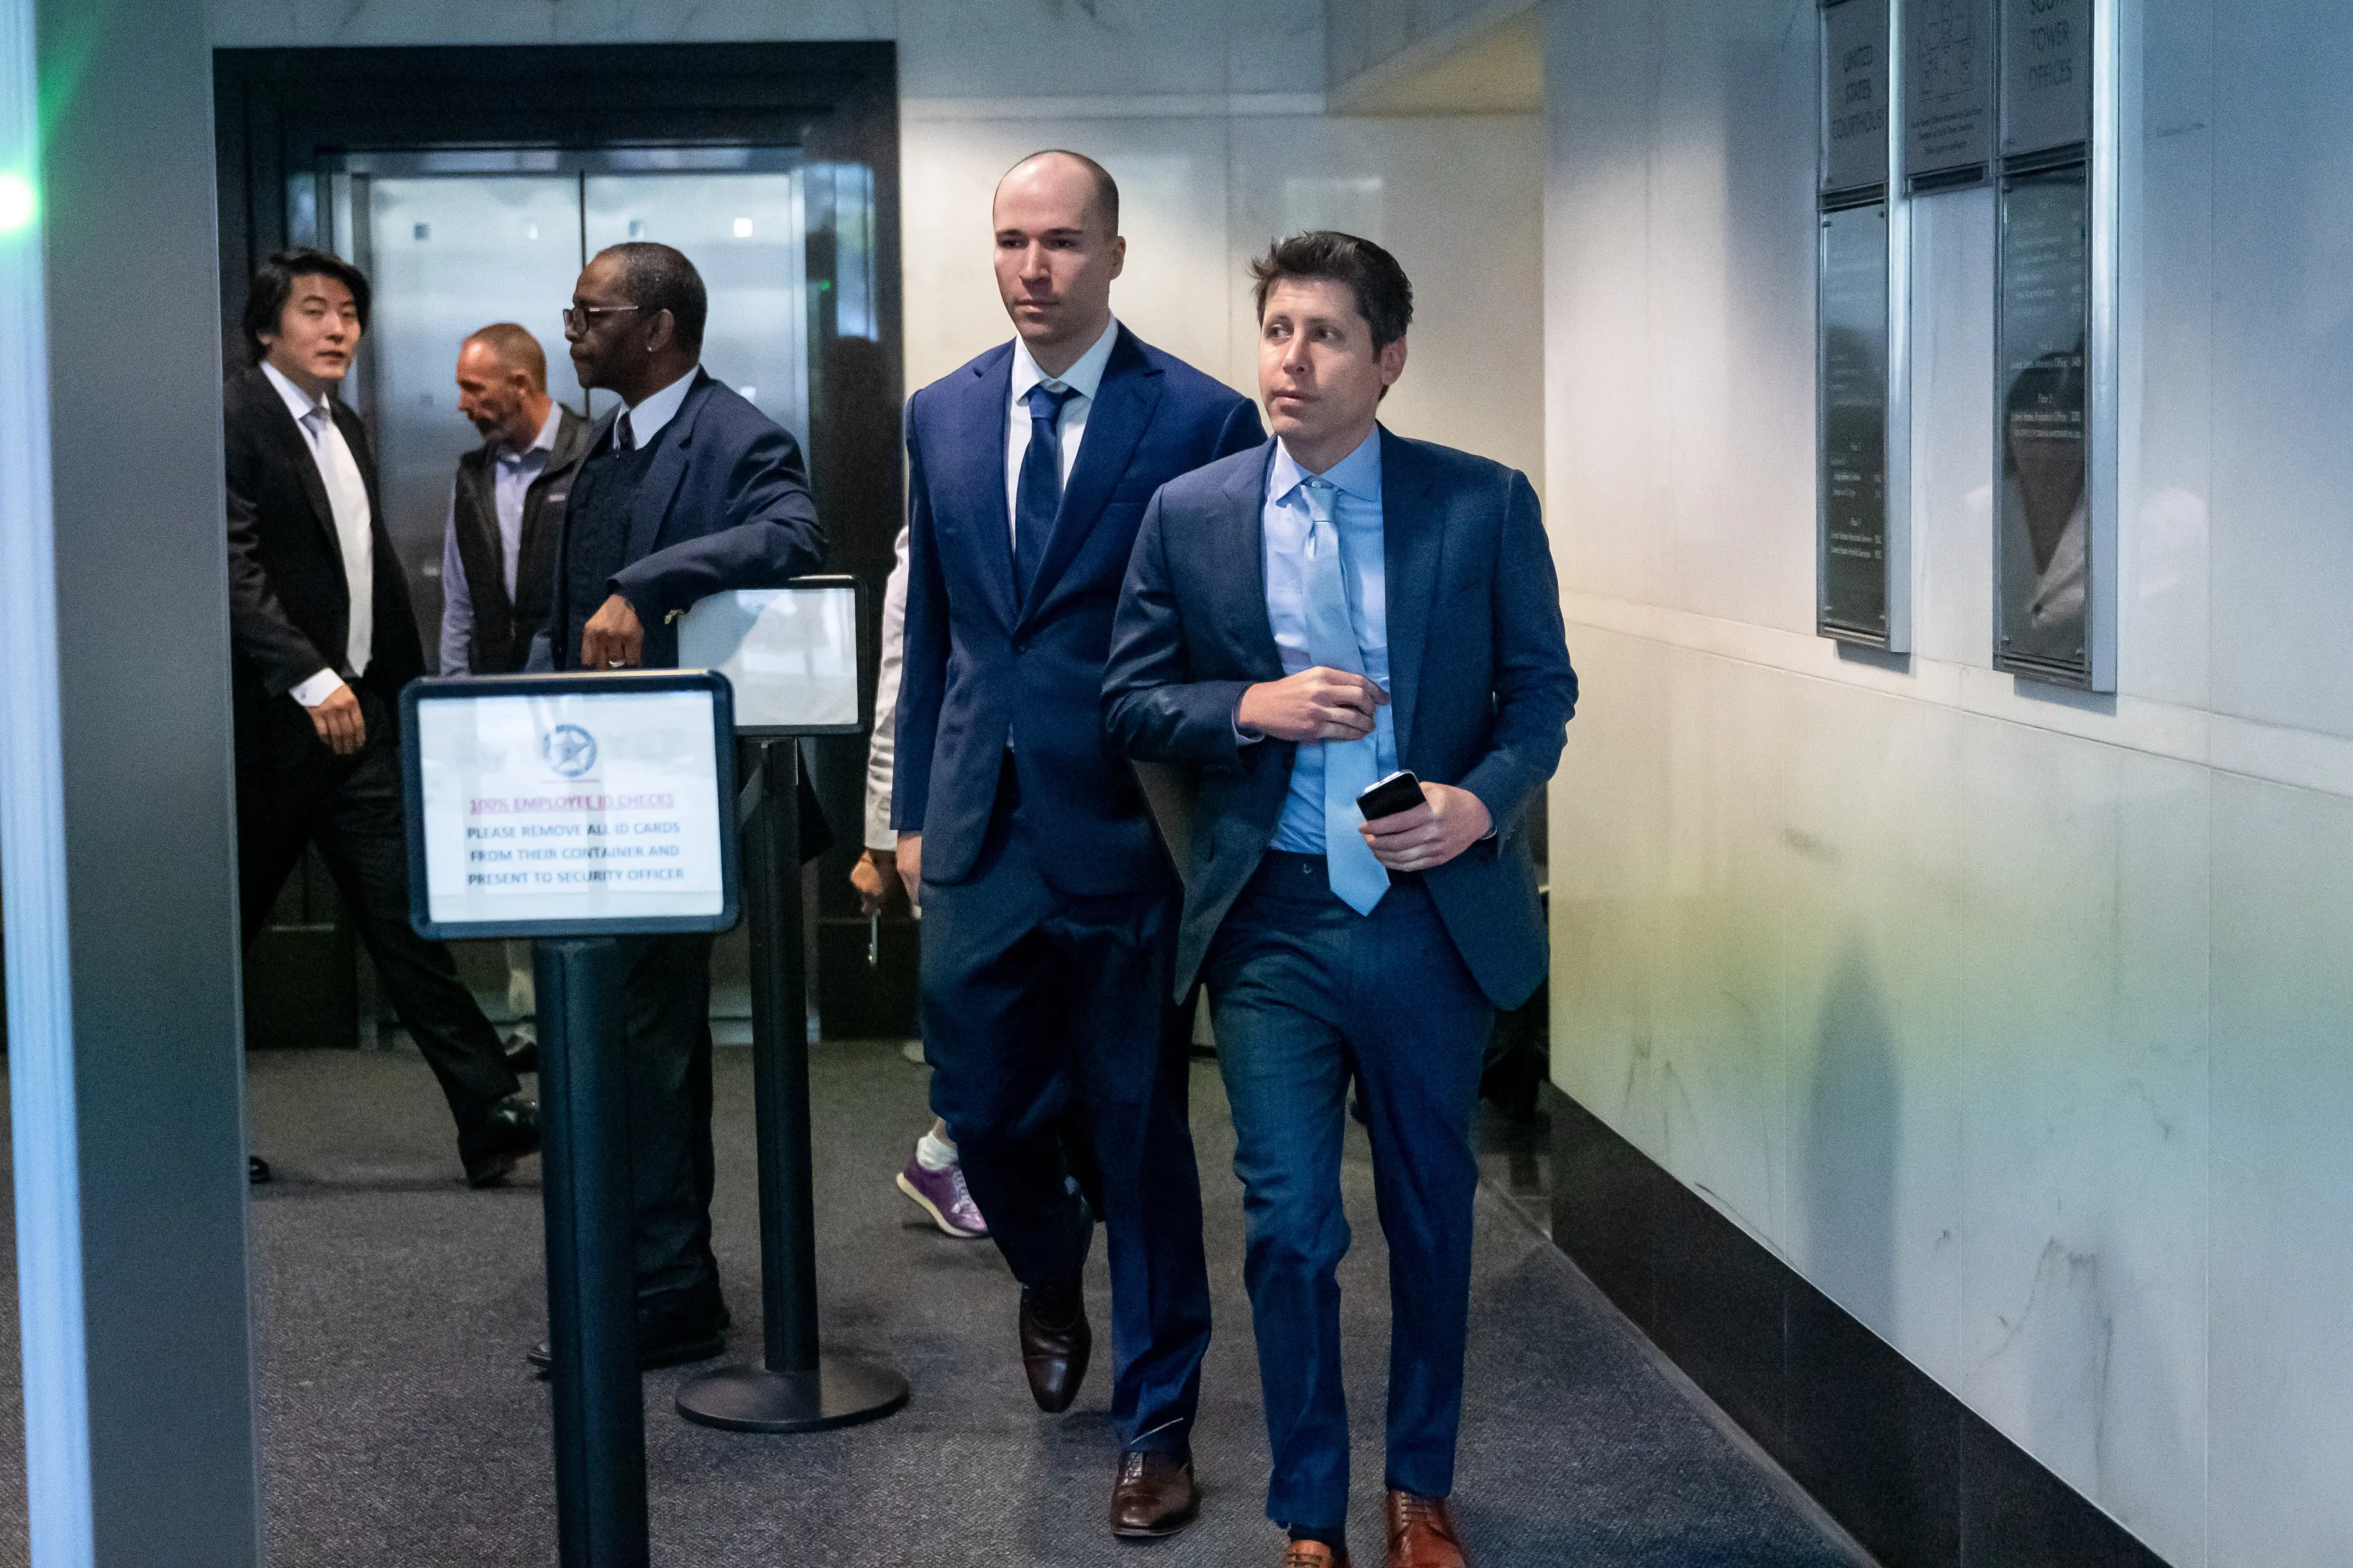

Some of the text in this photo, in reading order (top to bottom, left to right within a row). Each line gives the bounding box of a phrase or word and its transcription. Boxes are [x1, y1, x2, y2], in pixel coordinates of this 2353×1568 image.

[513, 796, 595, 812] EMPLOYEE
[598, 795, 614, 810] ID
[619, 794, 675, 809] CHECKS
[468, 821, 681, 839] PLEASE REMOVE ALL ID CARDS
[470, 845, 680, 862] FROM THEIR CONTAINER AND
[468, 868, 685, 886] PRESENT TO SECURITY OFFICER
